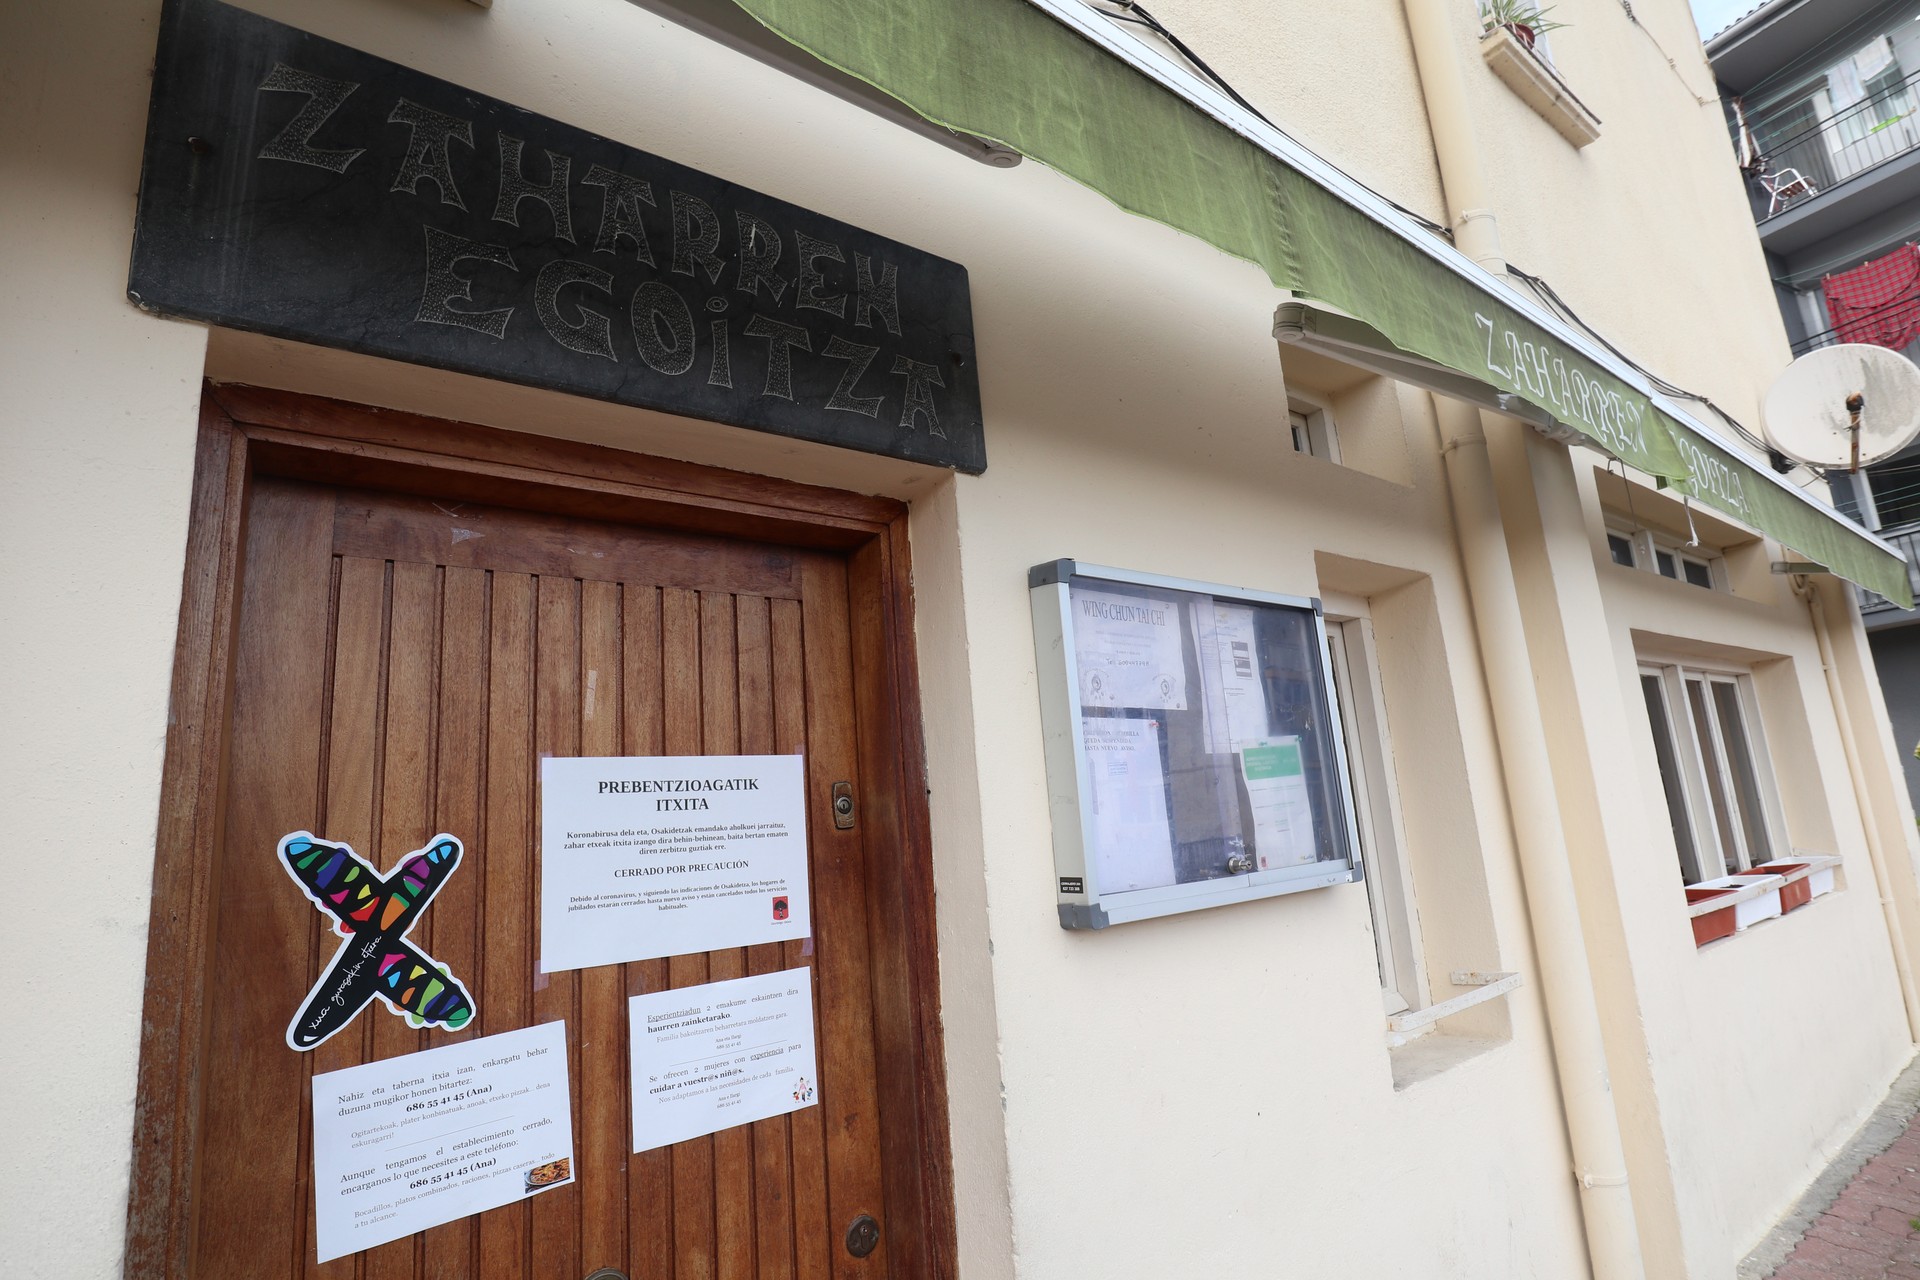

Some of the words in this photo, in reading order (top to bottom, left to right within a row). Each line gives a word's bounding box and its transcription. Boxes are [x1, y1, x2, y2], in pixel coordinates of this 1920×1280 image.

[258, 62, 902, 336] ZAHARREN
[1474, 311, 1648, 455] ZAHARREN
[1669, 430, 1750, 514] GOITZA
[1082, 600, 1108, 619] WING
[1109, 603, 1136, 622] CHUN
[1136, 607, 1150, 624] TAI
[1151, 609, 1166, 626] CHI
[598, 778, 759, 794] PREBENTZIOAGATIK
[656, 798, 709, 812] ITXITA
[564, 842, 586, 850] zahar
[587, 840, 611, 848] etxeak
[613, 839, 632, 847] itxita
[633, 838, 656, 847] izango
[673, 835, 726, 844] behin-behinean,
[727, 832, 744, 840] baita
[745, 831, 765, 839] bertan
[766, 830, 789, 838] ematen
[567, 830, 618, 839] Koronabirusa
[620, 829, 635, 837] dela
[651, 826, 693, 835] Osakidetzak
[694, 825, 728, 833] emandako
[729, 823, 756, 831] aholkuei
[757, 822, 786, 831] jarraituz,
[639, 847, 658, 855] diren
[659, 845, 687, 854] zerbitzu
[688, 844, 713, 853] guztiak
[614, 866, 664, 878] CERRADO
[666, 865, 686, 874] POR
[688, 859, 749, 873] PRECAUCIÓN
[570, 895, 592, 903] Debido
[600, 892, 637, 900] coronavirus,
[643, 888, 670, 897] siguiendo
[680, 885, 712, 893] indicaciones
[721, 882, 750, 890] Osakidetza,
[760, 879, 778, 887] hogares
[568, 903, 596, 913] jubilados
[597, 900, 619, 908] estarán
[620, 898, 646, 906] cerrados
[658, 902, 688, 911] habituales.
[361, 935, 382, 959] etxera
[647, 1007, 702, 1023] Esperientziadun
[716, 999, 747, 1009] emakume
[751, 992, 782, 1003] eskaintzen
[786, 988, 799, 996] dira
[648, 1022, 680, 1033] haurren
[656, 1033, 679, 1043] Familia
[680, 1027, 714, 1038] bakoitzaren
[715, 1021, 747, 1031] beharretara
[748, 1014, 774, 1025] moldatzen
[338, 1091, 364, 1104] Nahiz
[371, 1087, 385, 1096] eta
[392, 1077, 425, 1090] taberna
[432, 1070, 450, 1081] itxia
[457, 1065, 476, 1075] izan,
[482, 1053, 521, 1069] enkargatu
[526, 1046, 548, 1058] behar
[649, 1075, 658, 1083] Se
[663, 1069, 689, 1080] ofrecen
[704, 1060, 730, 1071] mujeres
[734, 1056, 746, 1064] con
[750, 1047, 784, 1061] experiencia
[788, 1043, 802, 1053] para
[338, 1103, 371, 1117] duzuna
[373, 1093, 410, 1108] mugikor
[411, 1086, 437, 1098] honen
[439, 1077, 473, 1091] bitartez:
[649, 1083, 676, 1095] cuidar
[683, 1074, 719, 1087] vuestr@s
[658, 1096, 671, 1104] Nos
[672, 1089, 705, 1101] adaptamos
[719, 1078, 751, 1090] necesidades
[759, 1071, 772, 1079] cada
[351, 1121, 399, 1140] Ogitartekoak,
[400, 1115, 421, 1127] plater
[422, 1104, 466, 1121] konbinatuak,
[489, 1092, 510, 1103] etxeko
[535, 1081, 551, 1090] dena
[406, 1101, 425, 1113] 686
[427, 1099, 439, 1109] 55
[440, 1096, 451, 1105] 41
[453, 1093, 465, 1102] 45
[466, 1084, 493, 1098] (Ana)
[340, 1167, 376, 1183] Aunque
[385, 1153, 427, 1170] tengamos
[435, 1146, 444, 1156] el
[452, 1128, 515, 1151] establecimiento
[522, 1117, 553, 1131] cerrado,
[351, 1131, 395, 1149] eskuragarri!
[341, 1175, 392, 1196] encarganos
[393, 1172, 402, 1181] lo
[403, 1168, 420, 1178] que
[421, 1156, 459, 1173] necesites
[466, 1149, 482, 1159] este
[484, 1139, 519, 1153] teléfono:
[409, 1178, 428, 1189] 686
[430, 1175, 442, 1184] 55
[444, 1171, 454, 1180] 41
[456, 1167, 468, 1176] 45
[470, 1157, 497, 1172] (Ana)
[354, 1203, 393, 1218] Bocadillos,
[395, 1195, 416, 1208] platos
[417, 1182, 460, 1199] combinados,
[461, 1173, 490, 1185] raciones,
[492, 1166, 511, 1178] pizzas
[541, 1152, 555, 1160] todo
[370, 1211, 398, 1224] alcance.
